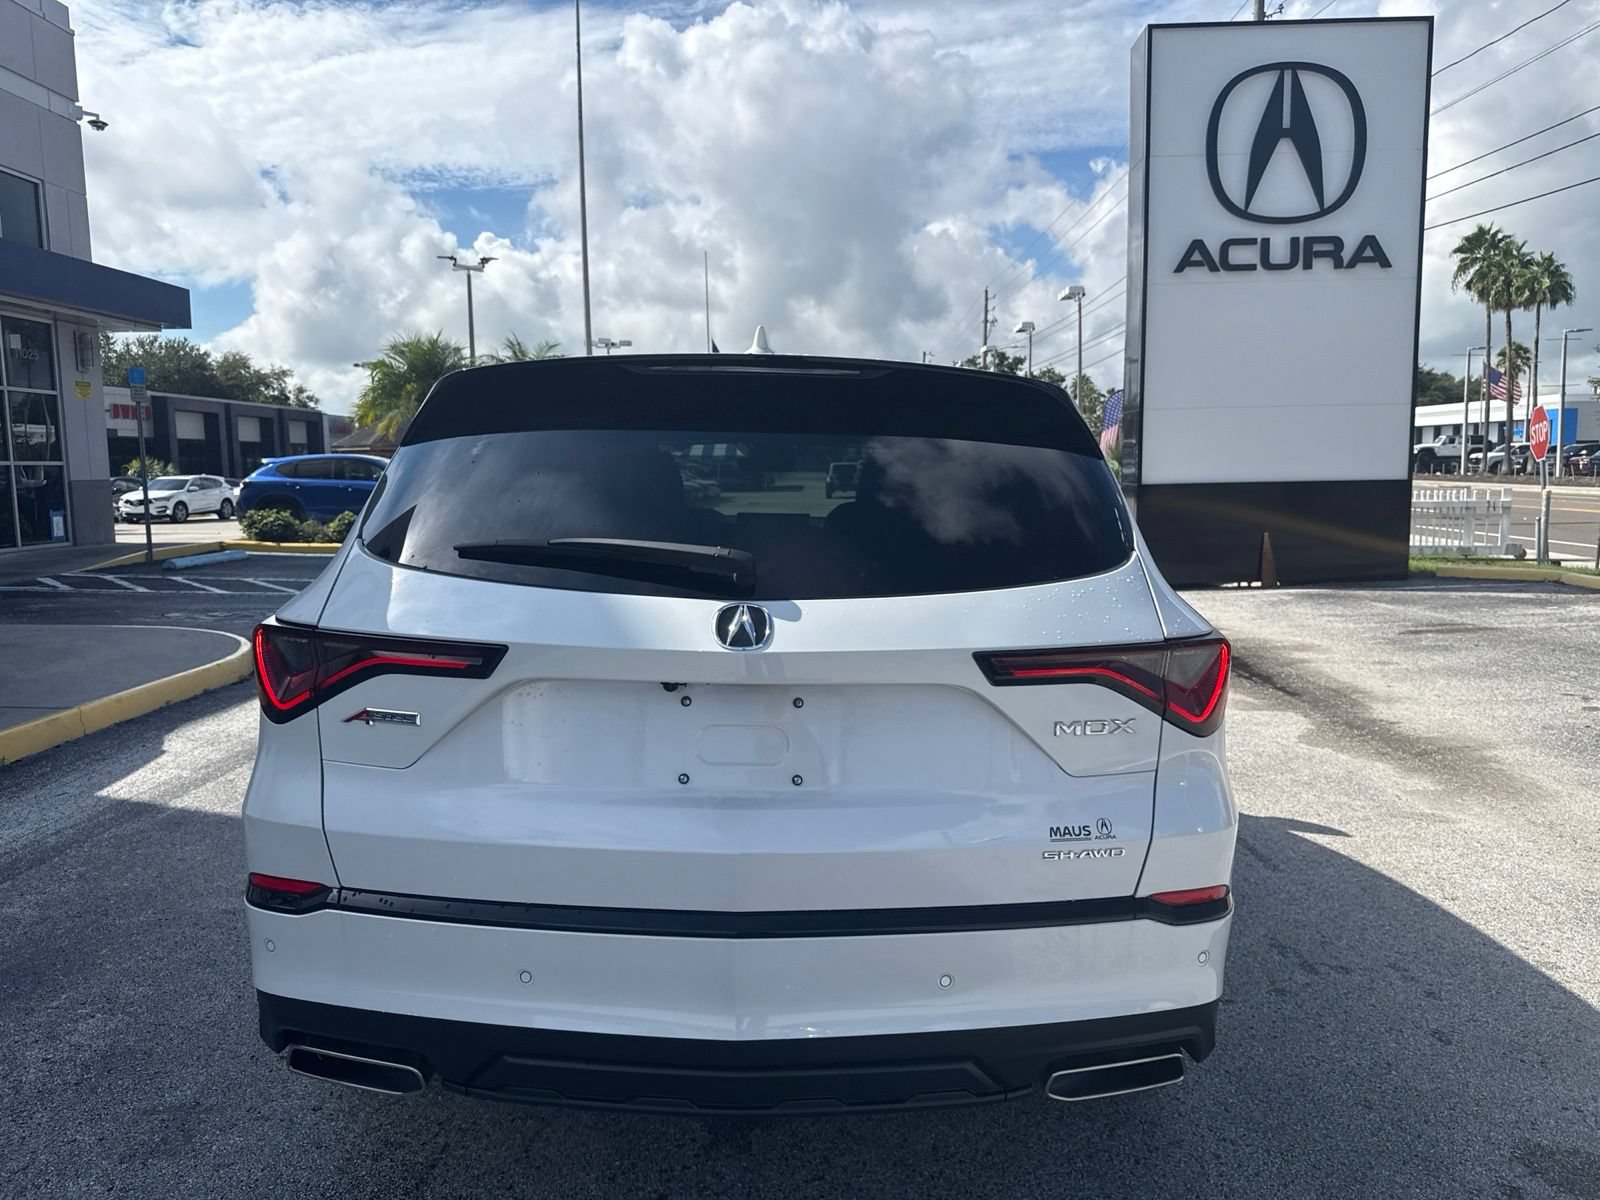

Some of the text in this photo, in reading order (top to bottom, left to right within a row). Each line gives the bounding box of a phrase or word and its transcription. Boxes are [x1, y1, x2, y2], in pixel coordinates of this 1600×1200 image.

[1173, 235, 1392, 273] ACURA
[1531, 420, 1548, 446] STOP
[1053, 718, 1136, 737] MDX
[1049, 825, 1092, 838] MAUS
[1042, 847, 1127, 861] SH-AWD
